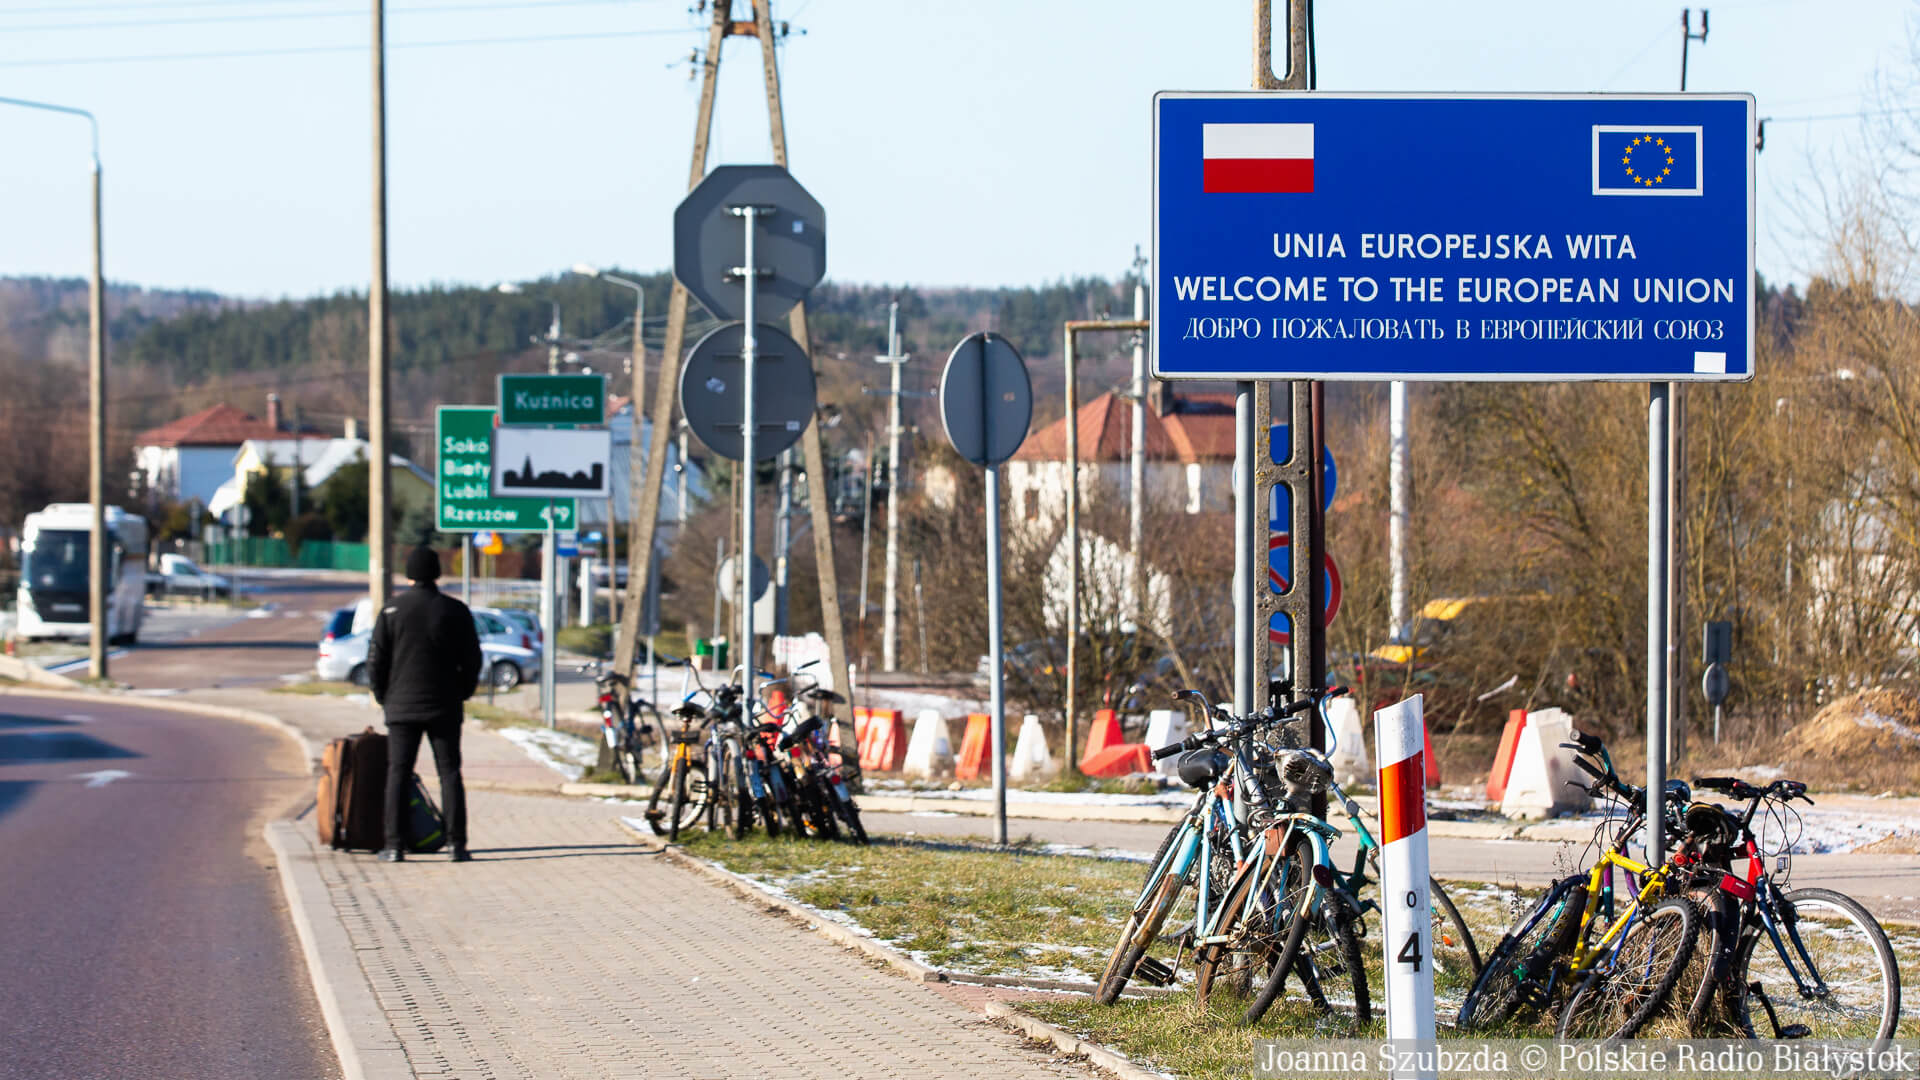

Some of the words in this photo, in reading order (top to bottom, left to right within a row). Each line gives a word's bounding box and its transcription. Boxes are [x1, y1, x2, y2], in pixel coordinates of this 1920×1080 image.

[1273, 233, 1346, 258] UNIA
[1361, 233, 1553, 259] EUROPEJSKA
[1565, 234, 1637, 259] WITA
[1173, 276, 1327, 302] WELCOME
[1338, 276, 1379, 302] TO
[1389, 277, 1444, 302] THE
[1458, 277, 1619, 303] EUROPEAN
[1633, 278, 1735, 303] UNION
[1183, 317, 1261, 341] ДОБРО
[1272, 318, 1445, 340] ПОЖАЛОВАТЬ
[1456, 319, 1470, 339] В
[1481, 317, 1643, 340] ЕВРОПЕЙСКИЙ
[1653, 319, 1725, 340] СОЮЗ
[514, 390, 594, 409] Kuźnica
[444, 435, 489, 454] Sokó
[444, 459, 492, 480] Biały
[444, 482, 489, 499] Lubli
[443, 505, 518, 522] Rzeszów
[1406, 890, 1417, 908] 0
[1397, 932, 1423, 973] 4
